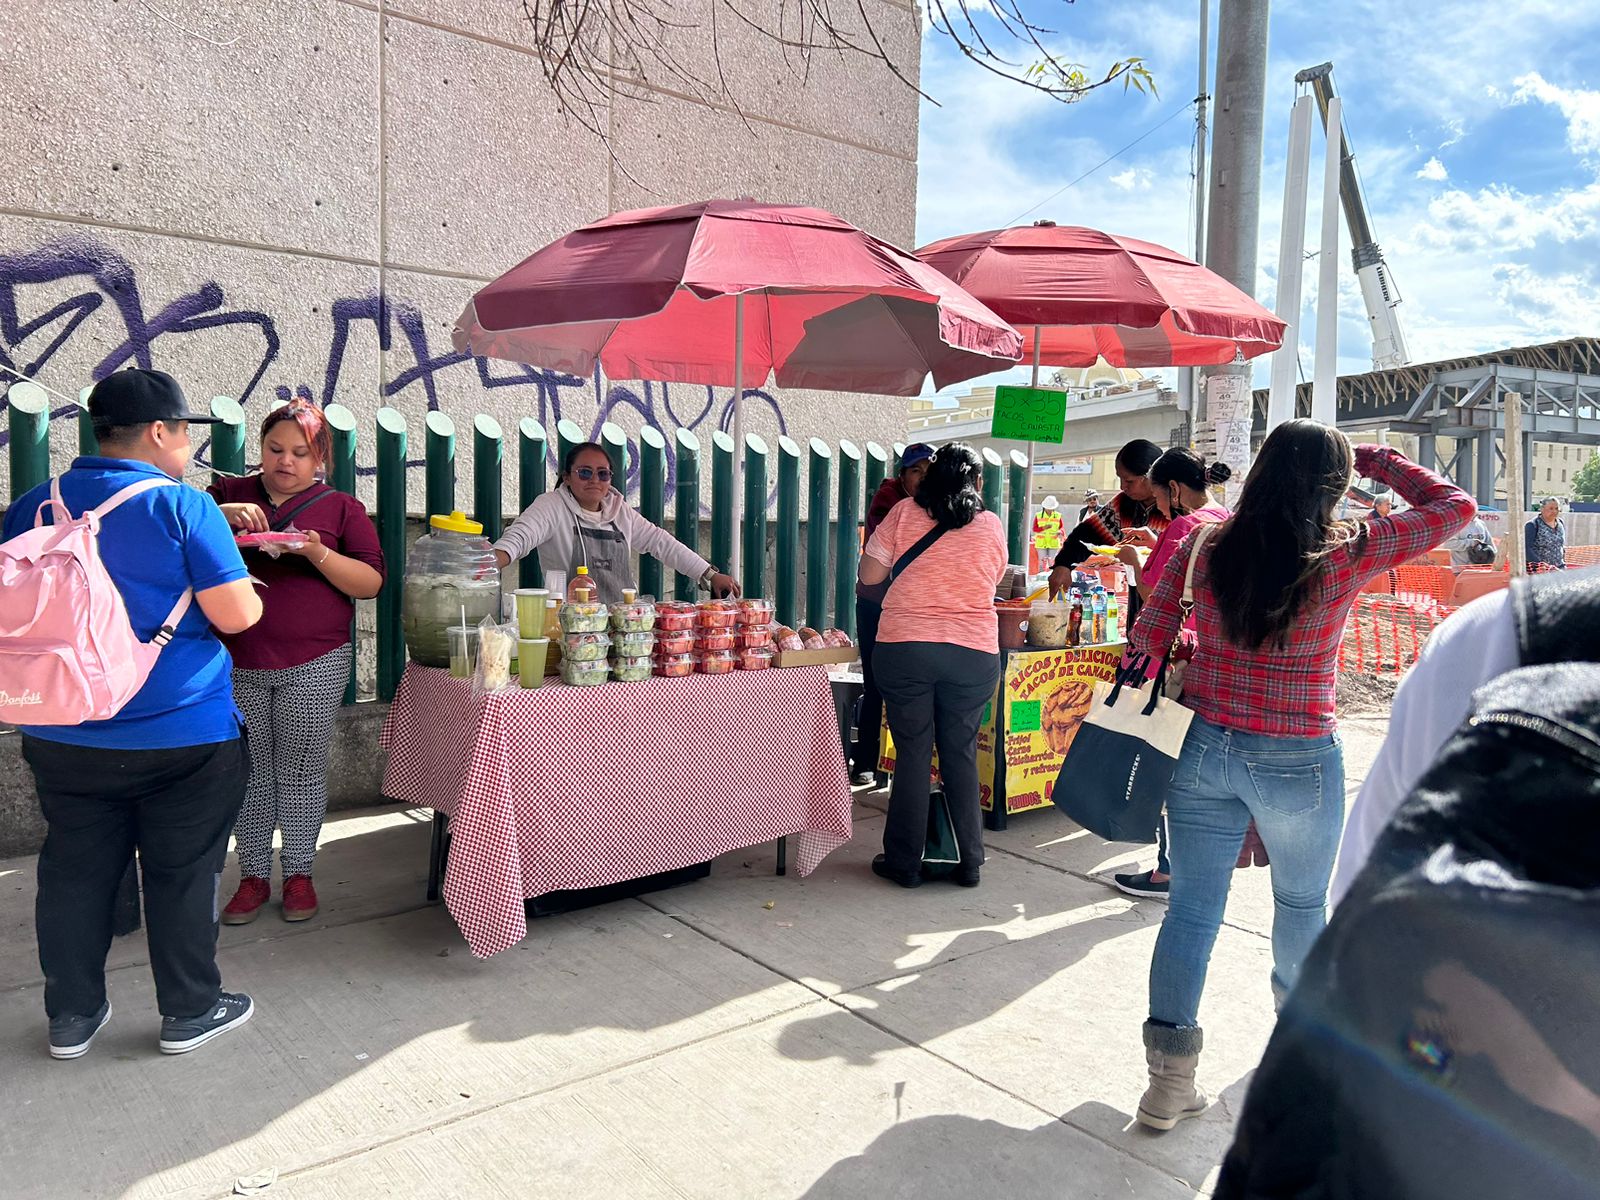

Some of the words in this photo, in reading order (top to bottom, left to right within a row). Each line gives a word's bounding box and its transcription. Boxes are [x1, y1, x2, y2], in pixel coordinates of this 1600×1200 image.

[1000, 388, 1016, 408] 5
[1032, 389, 1061, 416] 35
[996, 410, 1025, 422] TACOS
[1035, 415, 1047, 423] DE
[1020, 422, 1060, 432] CANASTA
[1009, 656, 1051, 691] RICOS
[1020, 668, 1056, 700] TACOS
[1058, 664, 1074, 678] DE
[0, 688, 43, 708] Danfoss
[1125, 755, 1141, 801] STARBUCKS
